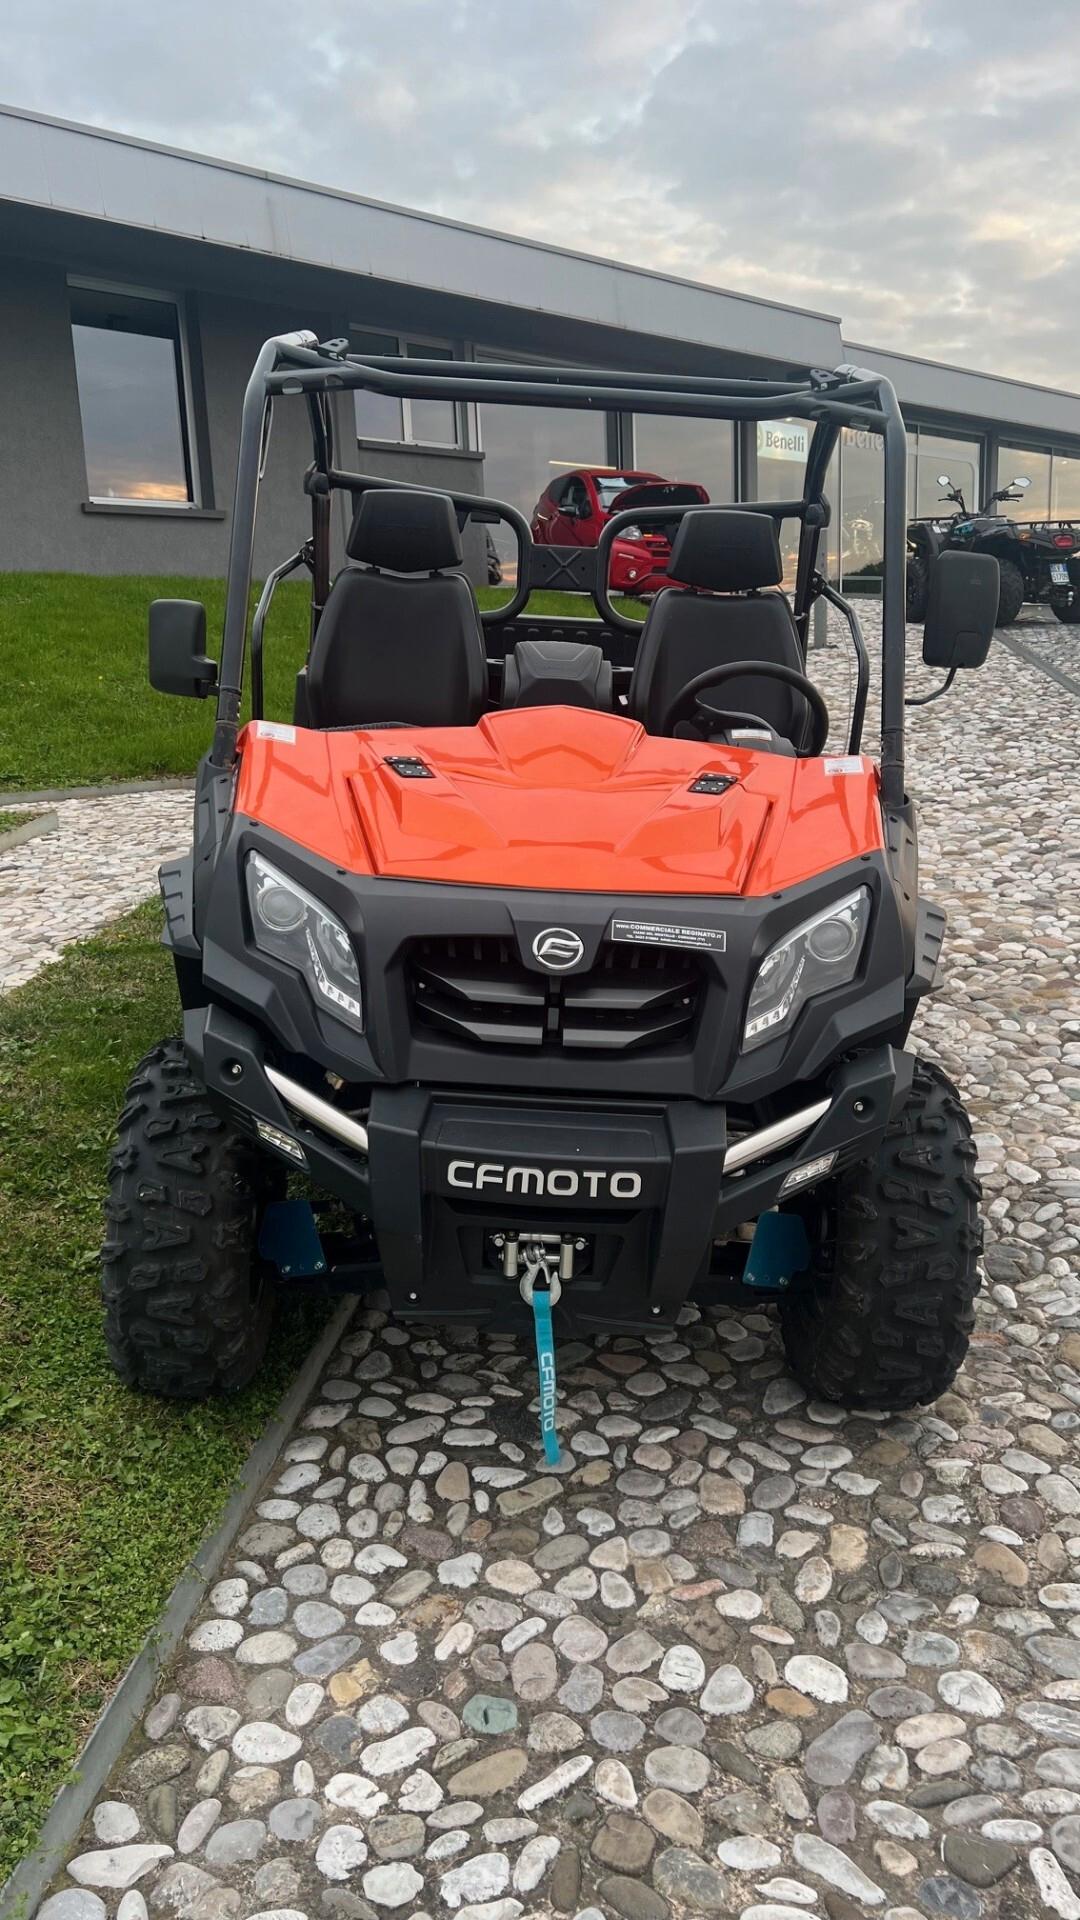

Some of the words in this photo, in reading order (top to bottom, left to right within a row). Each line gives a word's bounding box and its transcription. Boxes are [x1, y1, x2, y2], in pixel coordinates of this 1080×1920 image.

[766, 431, 804, 452] Benelli
[447, 1160, 642, 1198] CFMOTO
[541, 1352, 555, 1432] CFMOTO
